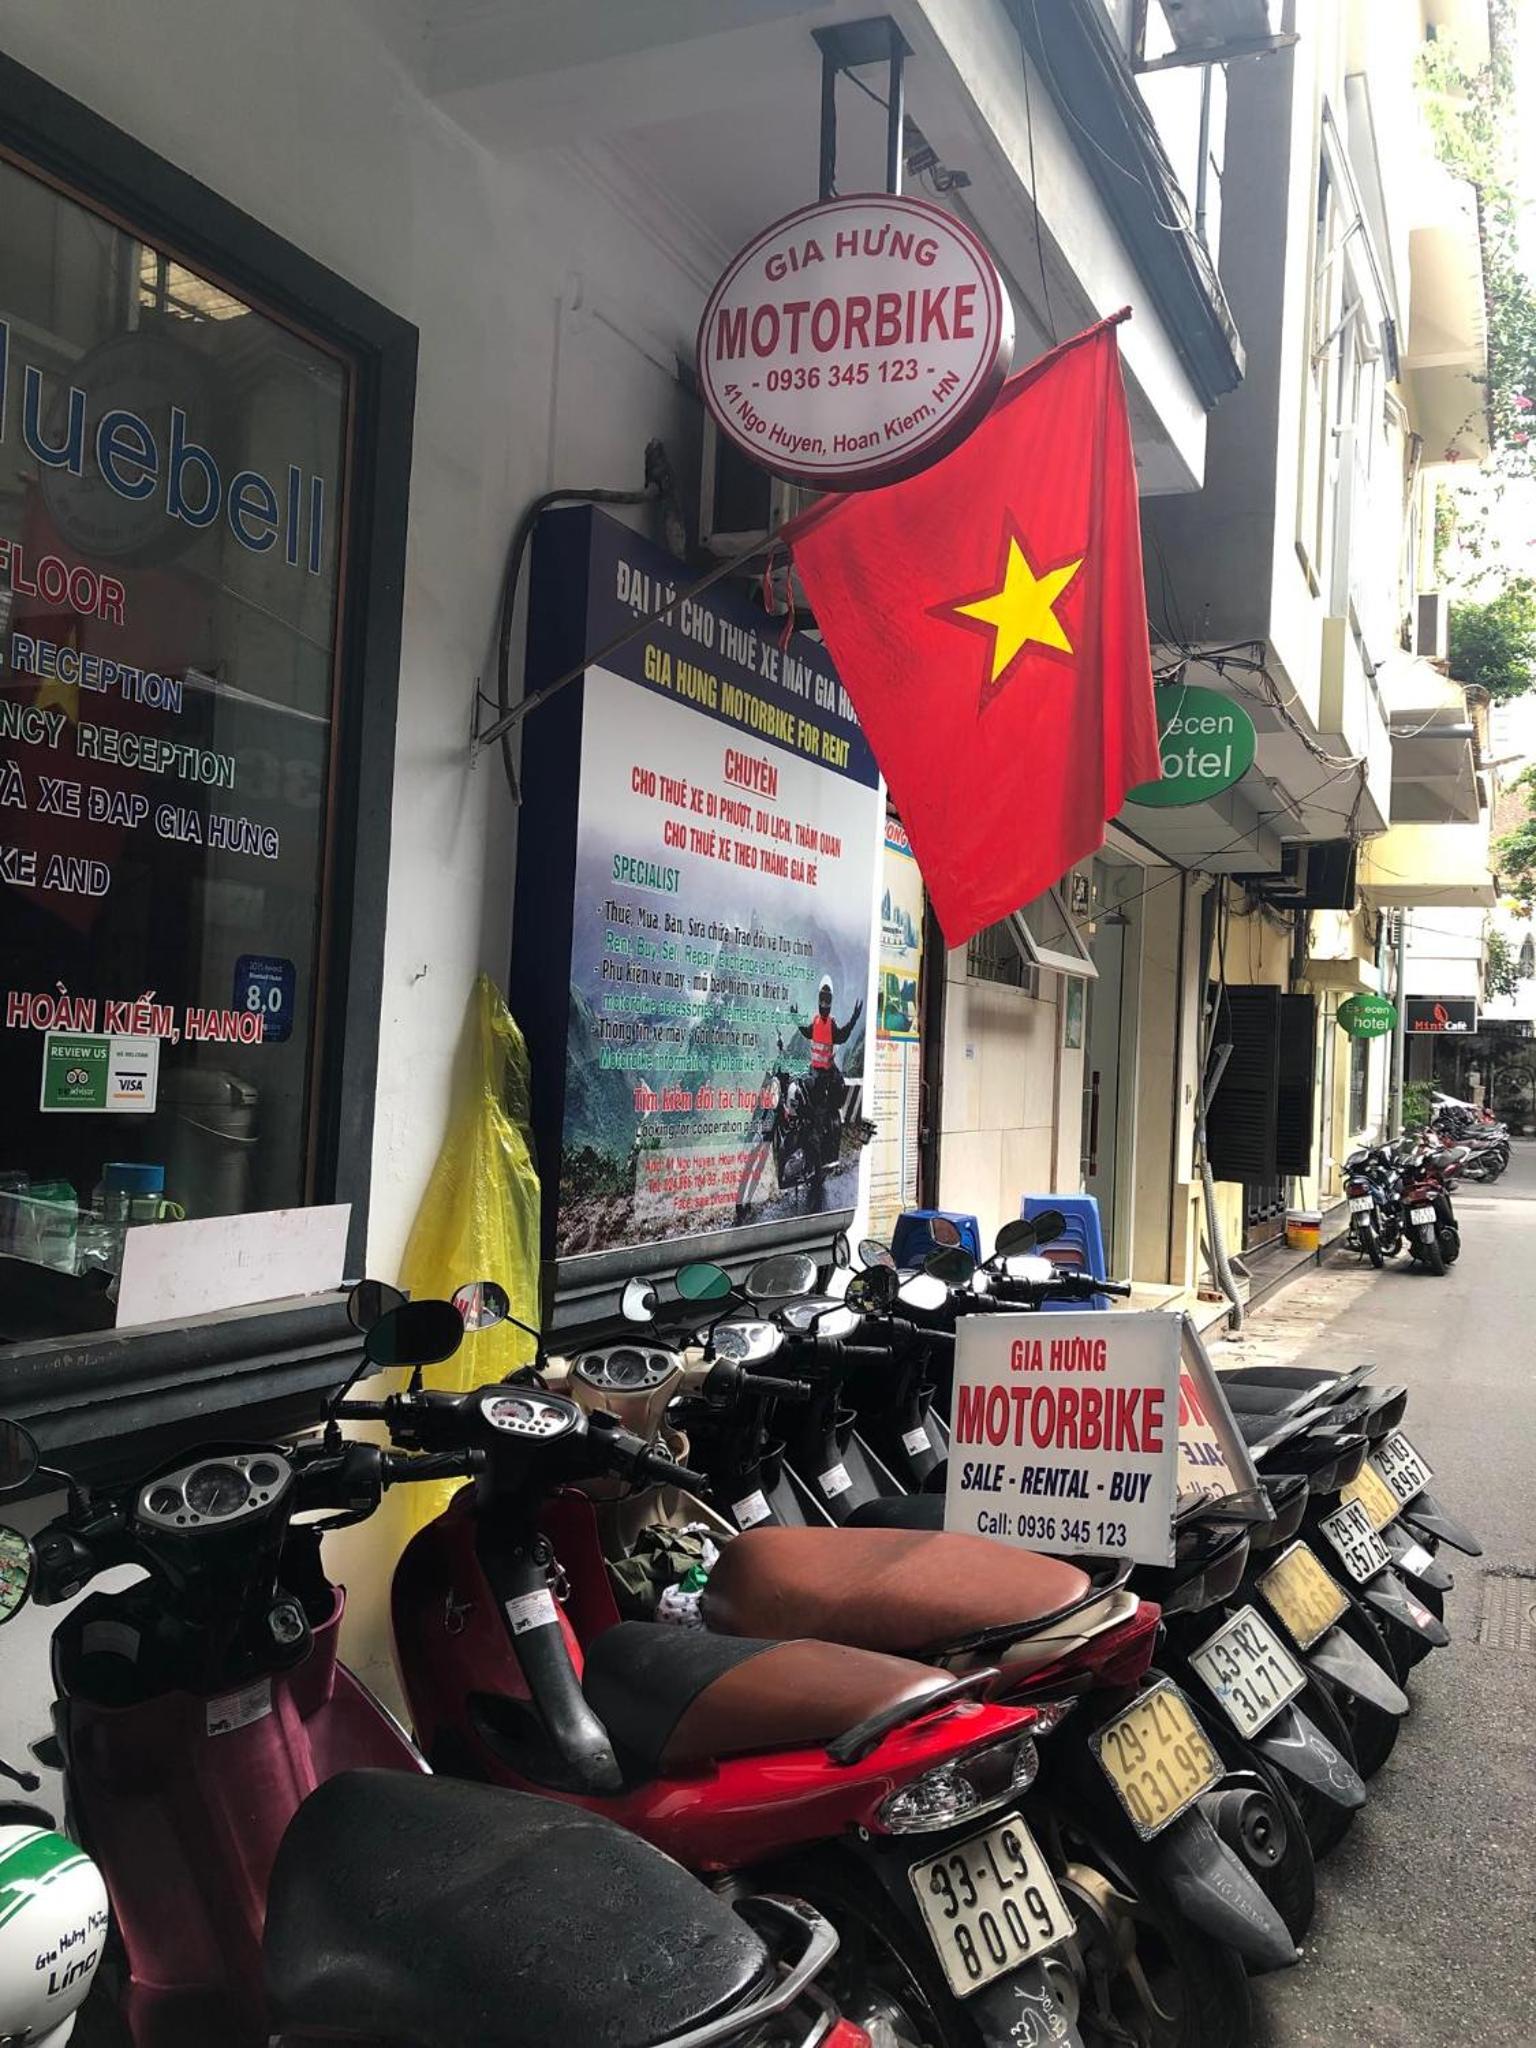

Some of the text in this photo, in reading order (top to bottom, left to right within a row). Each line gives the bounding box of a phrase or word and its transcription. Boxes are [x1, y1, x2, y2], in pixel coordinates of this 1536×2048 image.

[765, 224, 939, 282] GIA HƯNG
[716, 283, 977, 361] MOTORBIKE
[766, 365, 821, 392] 0936
[828, 361, 870, 387] 345
[877, 358, 919, 384] 123
[723, 369, 962, 456] 41 Ngo Huyen, Hoan Kiem, HN
[616, 559, 649, 618] ĐẠI
[680, 598, 714, 649] CHO
[719, 617, 756, 672] THUÊ
[759, 641, 778, 683] XE
[782, 653, 812, 699] MÁY
[815, 674, 835, 712] GIA
[11, 632, 183, 714] RECEPTION
[644, 643, 850, 769] GIA HUNG MOTORBIKE FOR RENT
[1166, 715, 1234, 735] ecen
[0, 702, 235, 789] NCY RECEPTION
[724, 748, 778, 796] CHUYÊN
[1161, 744, 1232, 779] otel
[37, 776, 81, 818] XE
[155, 803, 202, 845] GIA
[208, 814, 280, 860] HƯNG
[631, 766, 656, 798] CHO
[689, 789, 705, 814] XE
[707, 792, 718, 818] ĐI
[756, 810, 769, 835] DU
[820, 831, 842, 858] QUAN
[664, 820, 688, 849] CHO
[717, 837, 731, 863] XE
[733, 842, 757, 869] THEO
[44, 854, 110, 896] AND
[613, 854, 681, 892] SPECIALIST
[6, 981, 264, 1045] HOÀN KIẾM, HANOI
[246, 985, 283, 1013] 8,0
[1354, 1016, 1389, 1030] hotel
[51, 1046, 92, 1058] REVIEW
[93, 1047, 107, 1059] US
[119, 1079, 143, 1091] VISA
[1011, 1336, 1106, 1372] GIA HƯNG
[956, 1385, 1165, 1454] MOTORBIKE
[961, 1462, 1005, 1492] SALE
[1020, 1465, 1090, 1499] RENTAL
[1109, 1471, 1152, 1503] BUY
[1390, 1460, 1427, 1498] 8967
[977, 1510, 1128, 1547] Call: 0936 345 123
[1206, 1622, 1269, 1684] 43-R2
[1232, 1655, 1293, 1723] 3471
[1107, 1694, 1182, 1775] 29-Z1
[1125, 1731, 1214, 1827] 031.95
[954, 1886, 1055, 1979] 8009
[47, 1949, 98, 1996] Lino
